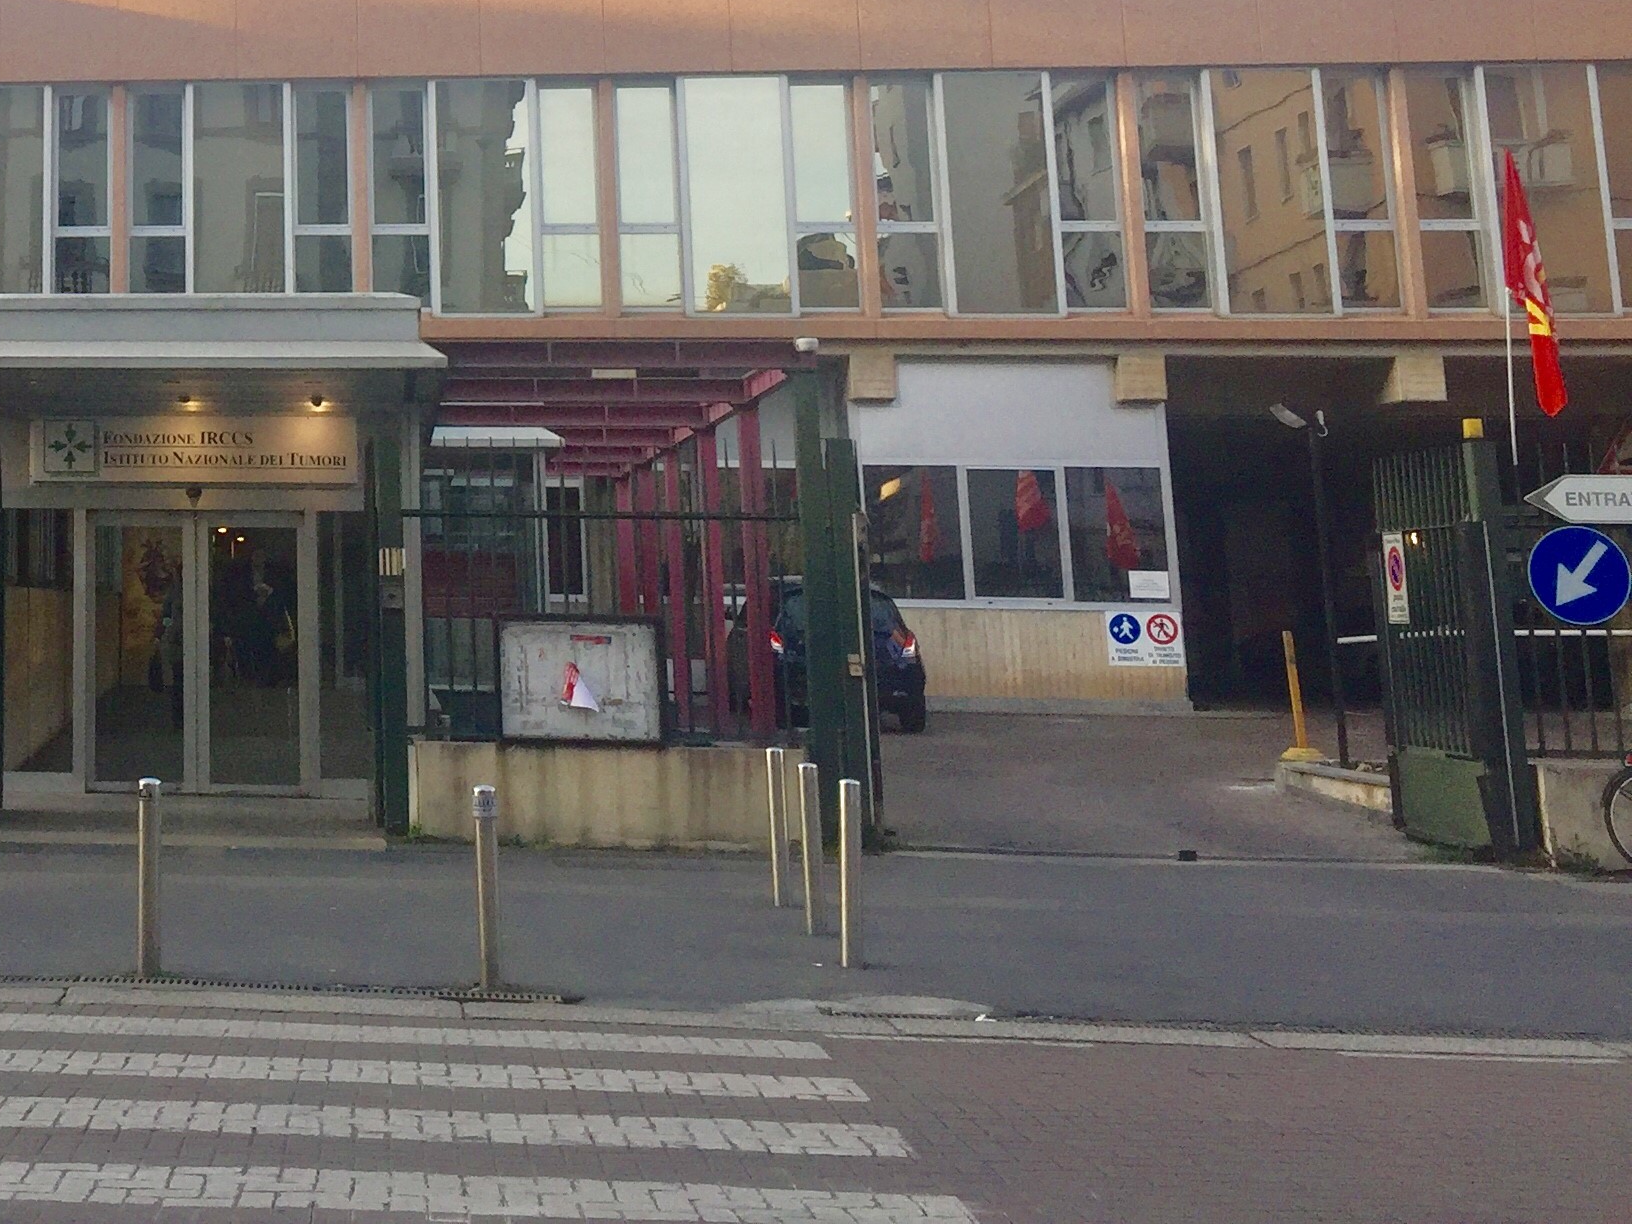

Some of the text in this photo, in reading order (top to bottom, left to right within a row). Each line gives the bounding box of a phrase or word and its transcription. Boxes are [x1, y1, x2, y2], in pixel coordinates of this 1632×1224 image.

[104, 431, 254, 445] FONDAZIONE IRCCS
[104, 451, 169, 465] ISTITUTO
[172, 451, 257, 466] NAZIONALE
[287, 452, 347, 467] TUMORI
